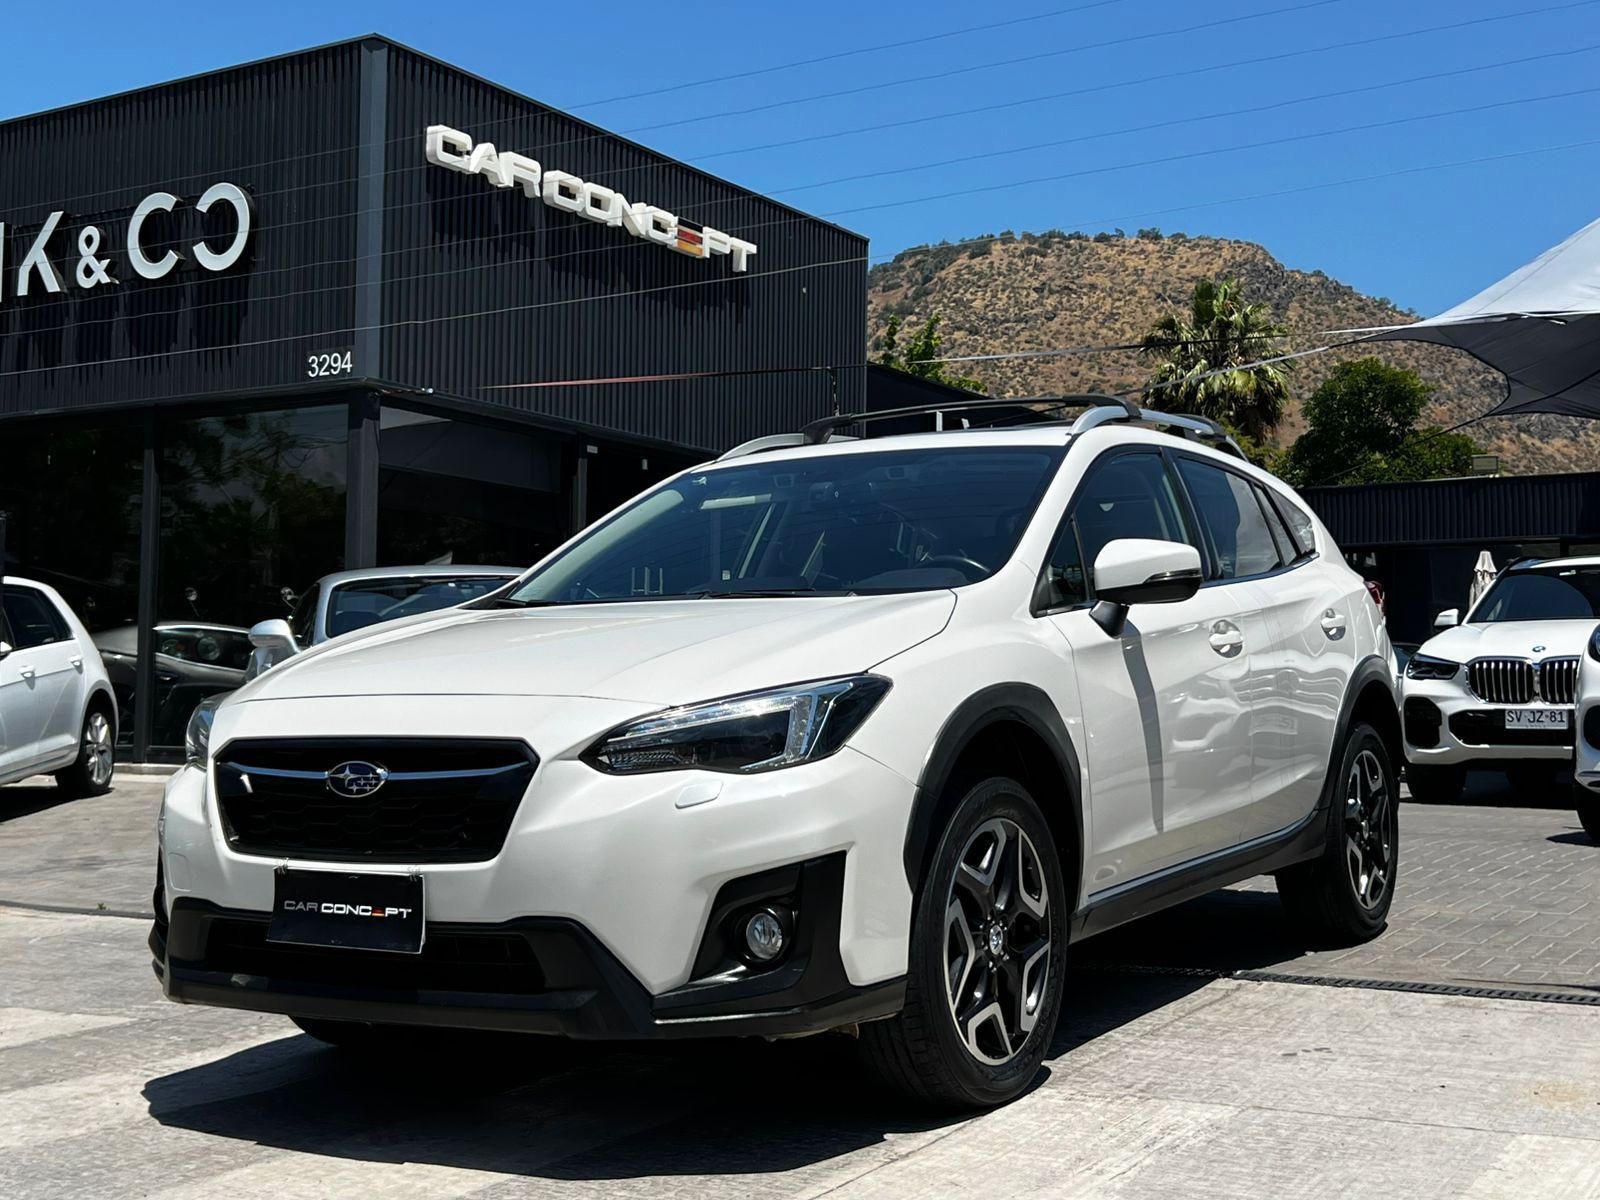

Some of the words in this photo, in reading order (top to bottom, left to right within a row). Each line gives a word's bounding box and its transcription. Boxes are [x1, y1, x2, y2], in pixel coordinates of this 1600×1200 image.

[426, 125, 541, 197] CAR
[308, 351, 353, 378] 3294
[284, 900, 318, 912] CAR
